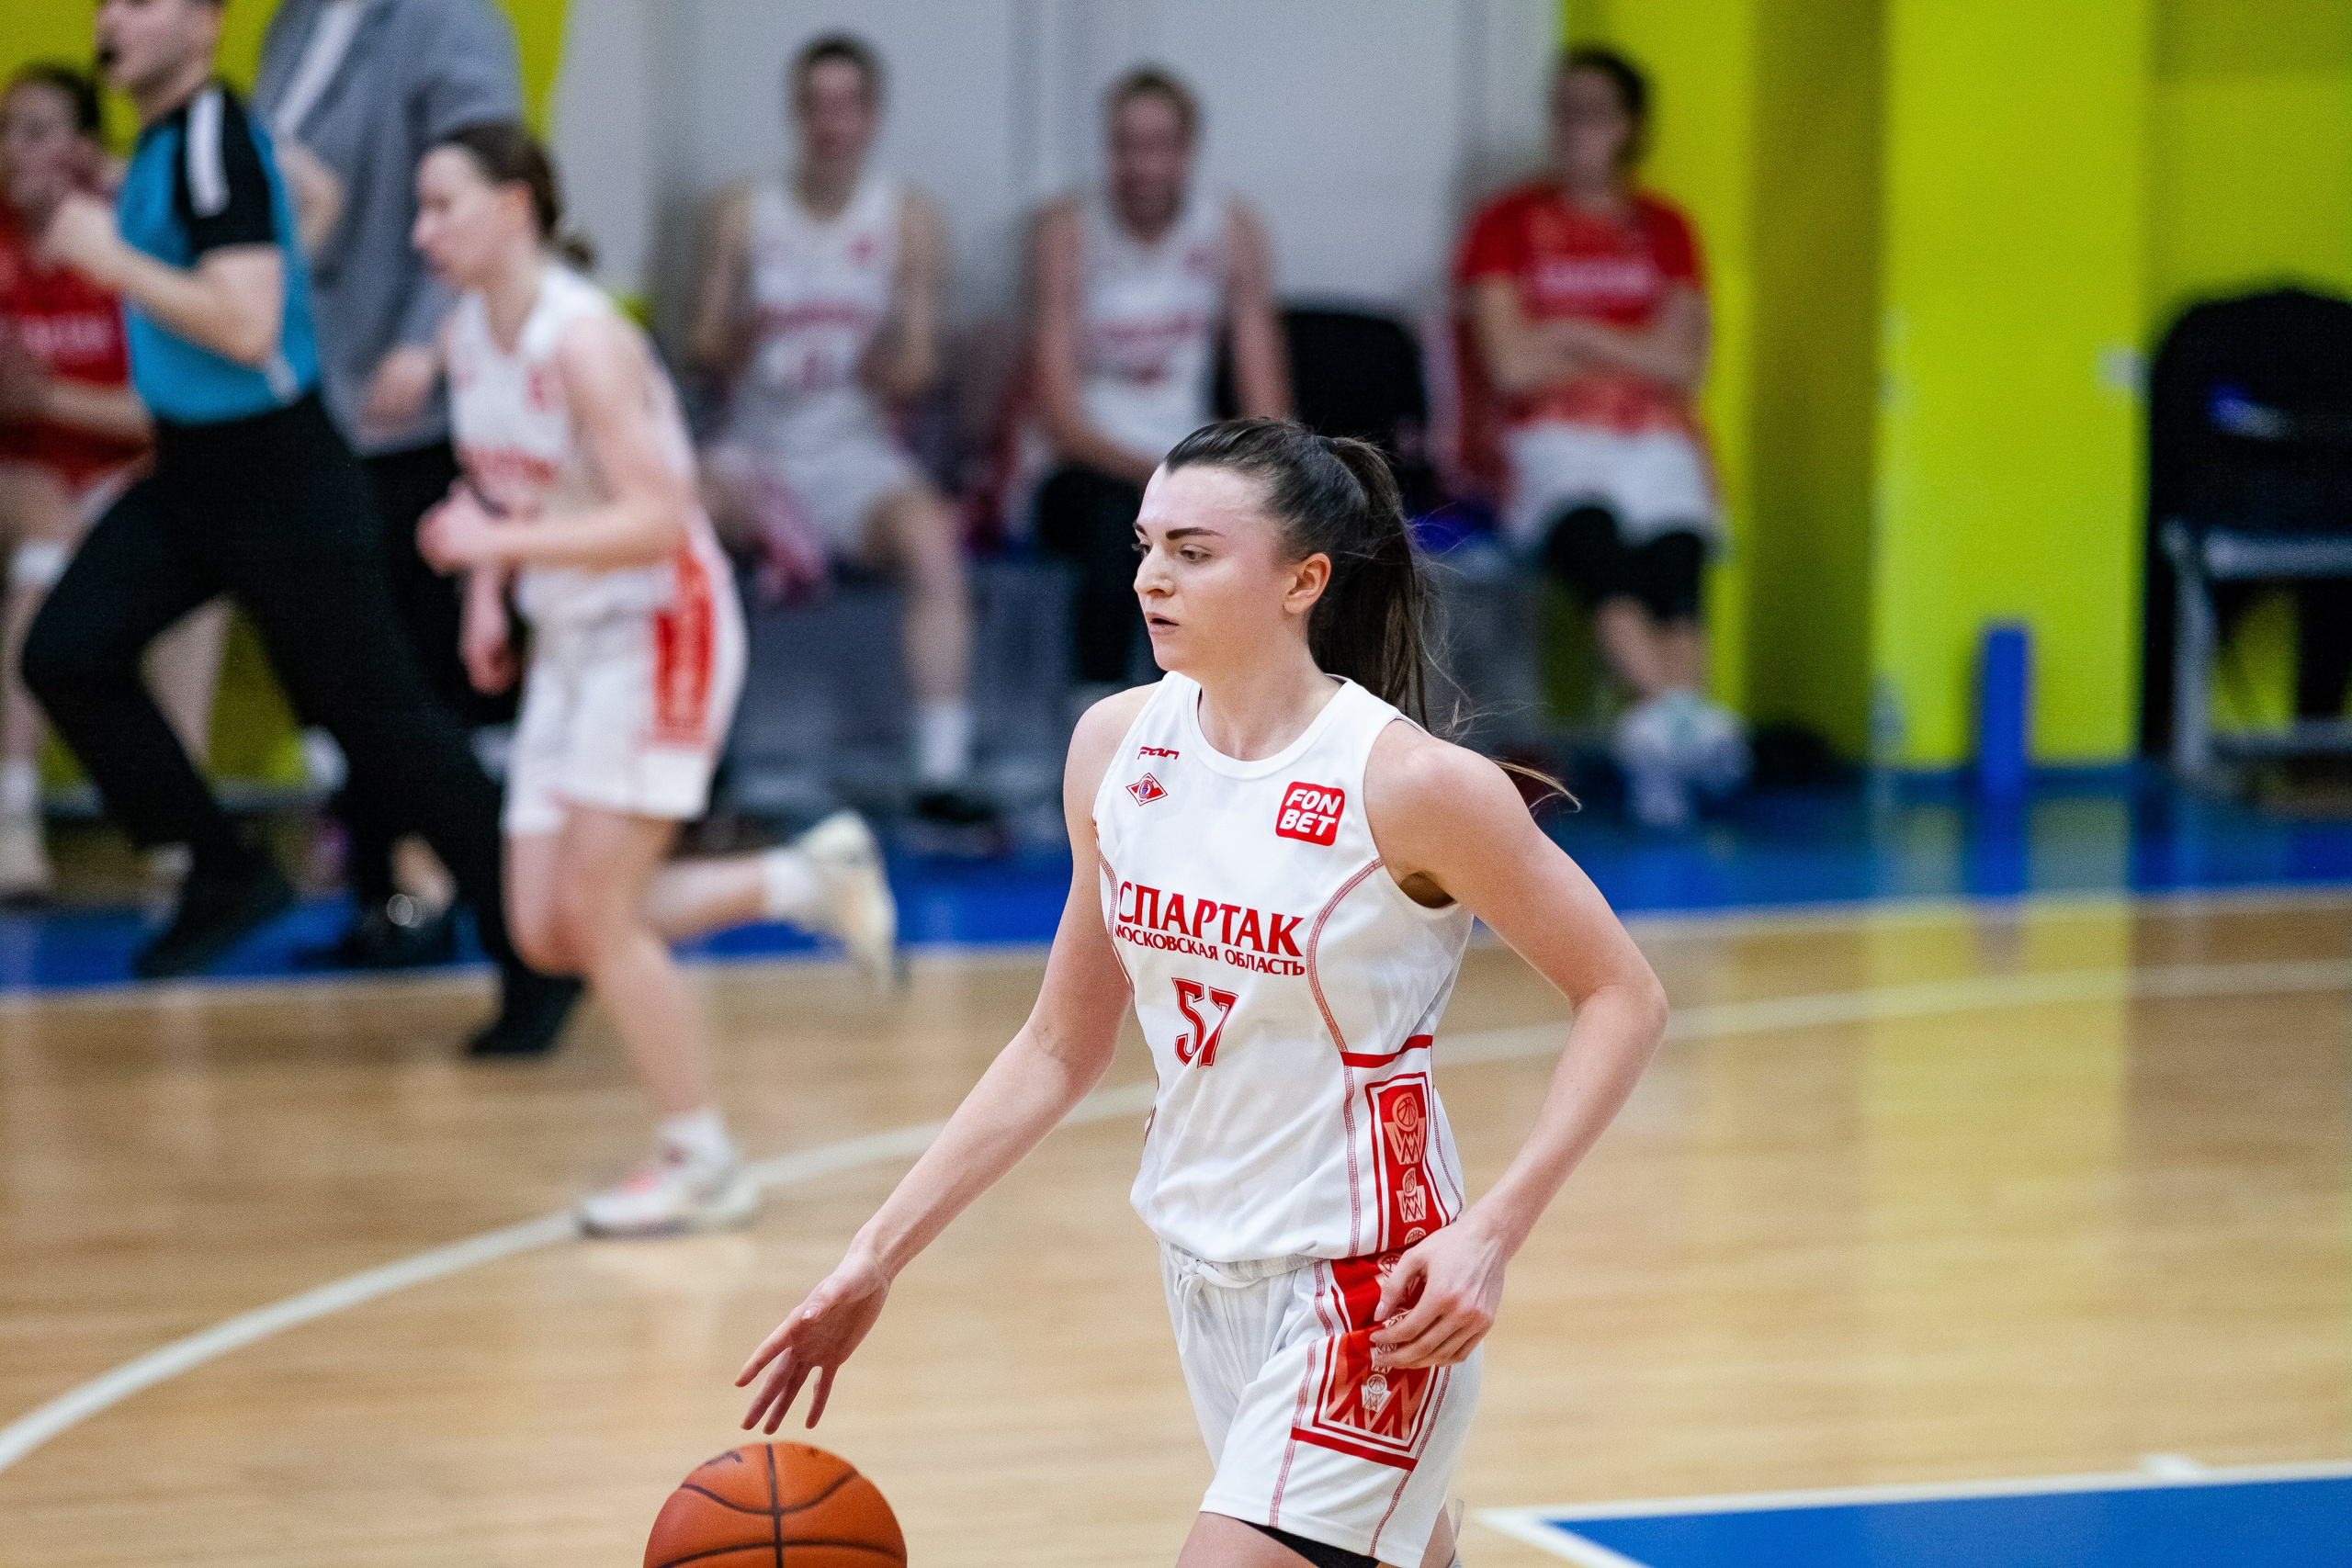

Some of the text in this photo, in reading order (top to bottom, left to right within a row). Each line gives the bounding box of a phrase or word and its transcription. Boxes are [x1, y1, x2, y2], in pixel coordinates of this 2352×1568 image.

[1285, 788, 1342, 815] FON
[1279, 808, 1337, 837] BET
[1118, 880, 1305, 957] СПАРТАК
[1225, 949, 1306, 976] ОБЛАСТЬ
[1170, 976, 1239, 1069] 57
